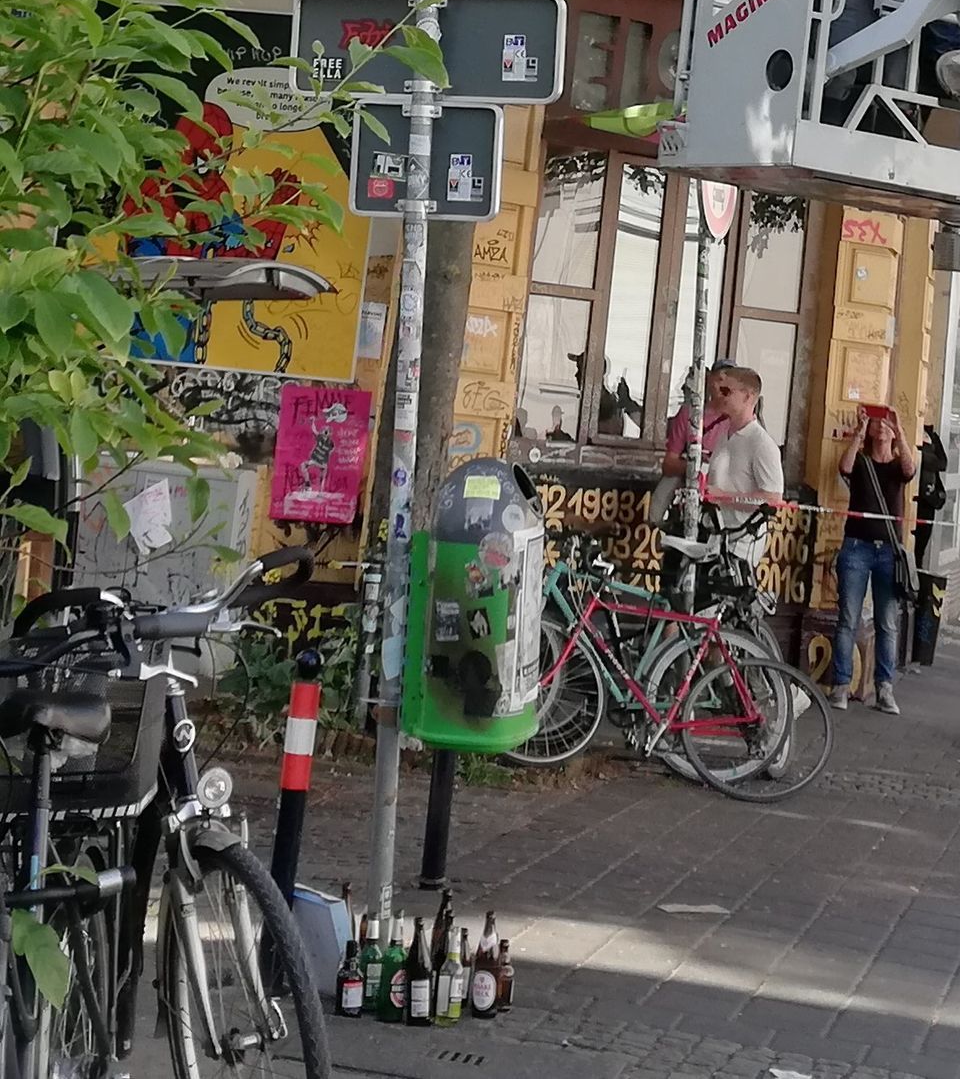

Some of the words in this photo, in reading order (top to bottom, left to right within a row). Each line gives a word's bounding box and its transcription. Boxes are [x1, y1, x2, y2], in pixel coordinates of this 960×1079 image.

[312, 58, 343, 69] FREE
[269, 79, 291, 90] simp
[270, 91, 293, 102] many
[279, 103, 303, 112] longe
